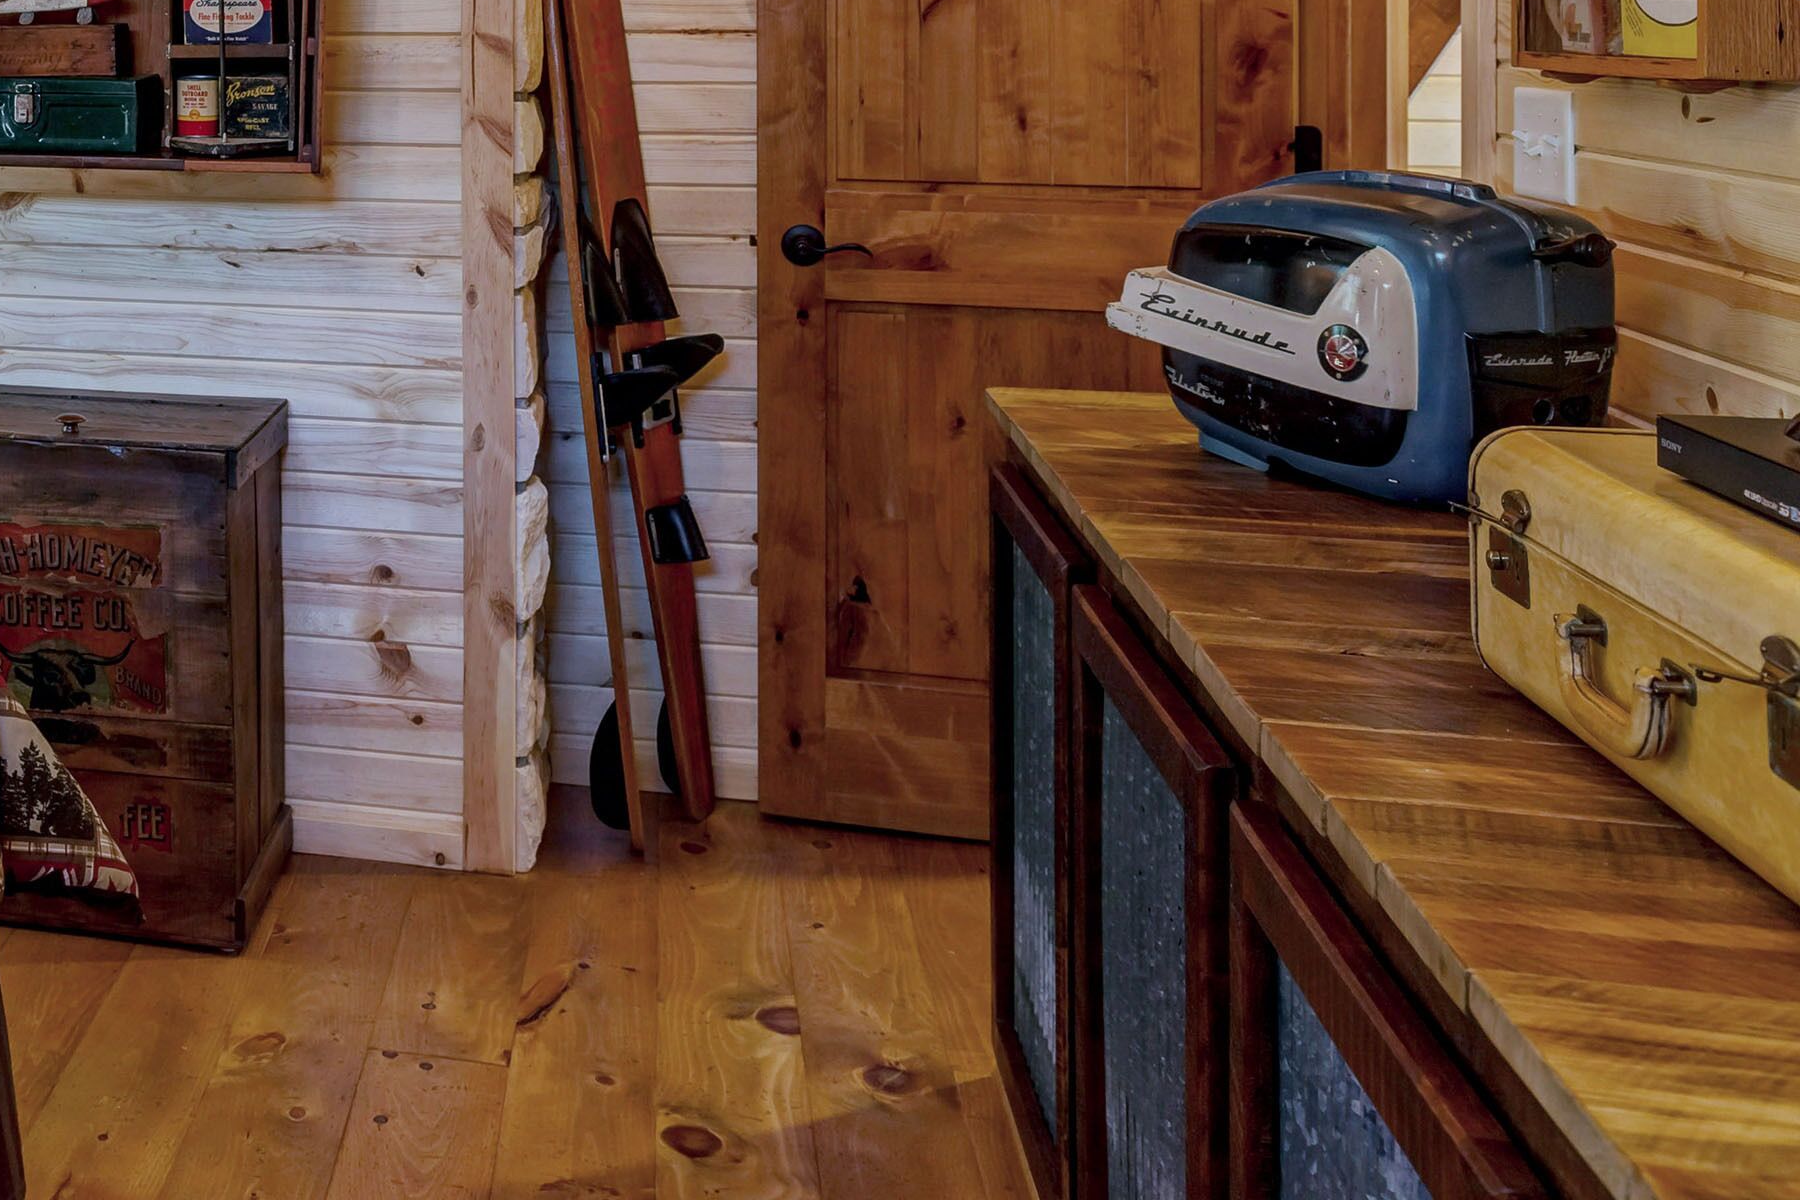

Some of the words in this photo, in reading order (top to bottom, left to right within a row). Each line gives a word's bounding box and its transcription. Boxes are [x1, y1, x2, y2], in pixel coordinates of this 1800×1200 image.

[198, 12, 210, 20] Fine
[212, 12, 234, 21] Fing
[235, 12, 255, 20] Tackle
[226, 81, 276, 107] Bronson
[1139, 292, 1296, 356] Evinrude
[1483, 352, 1554, 367] Evinrude
[1660, 437, 1683, 454] SONY
[93, 596, 131, 632] CO.
[115, 667, 163, 705] BRAND
